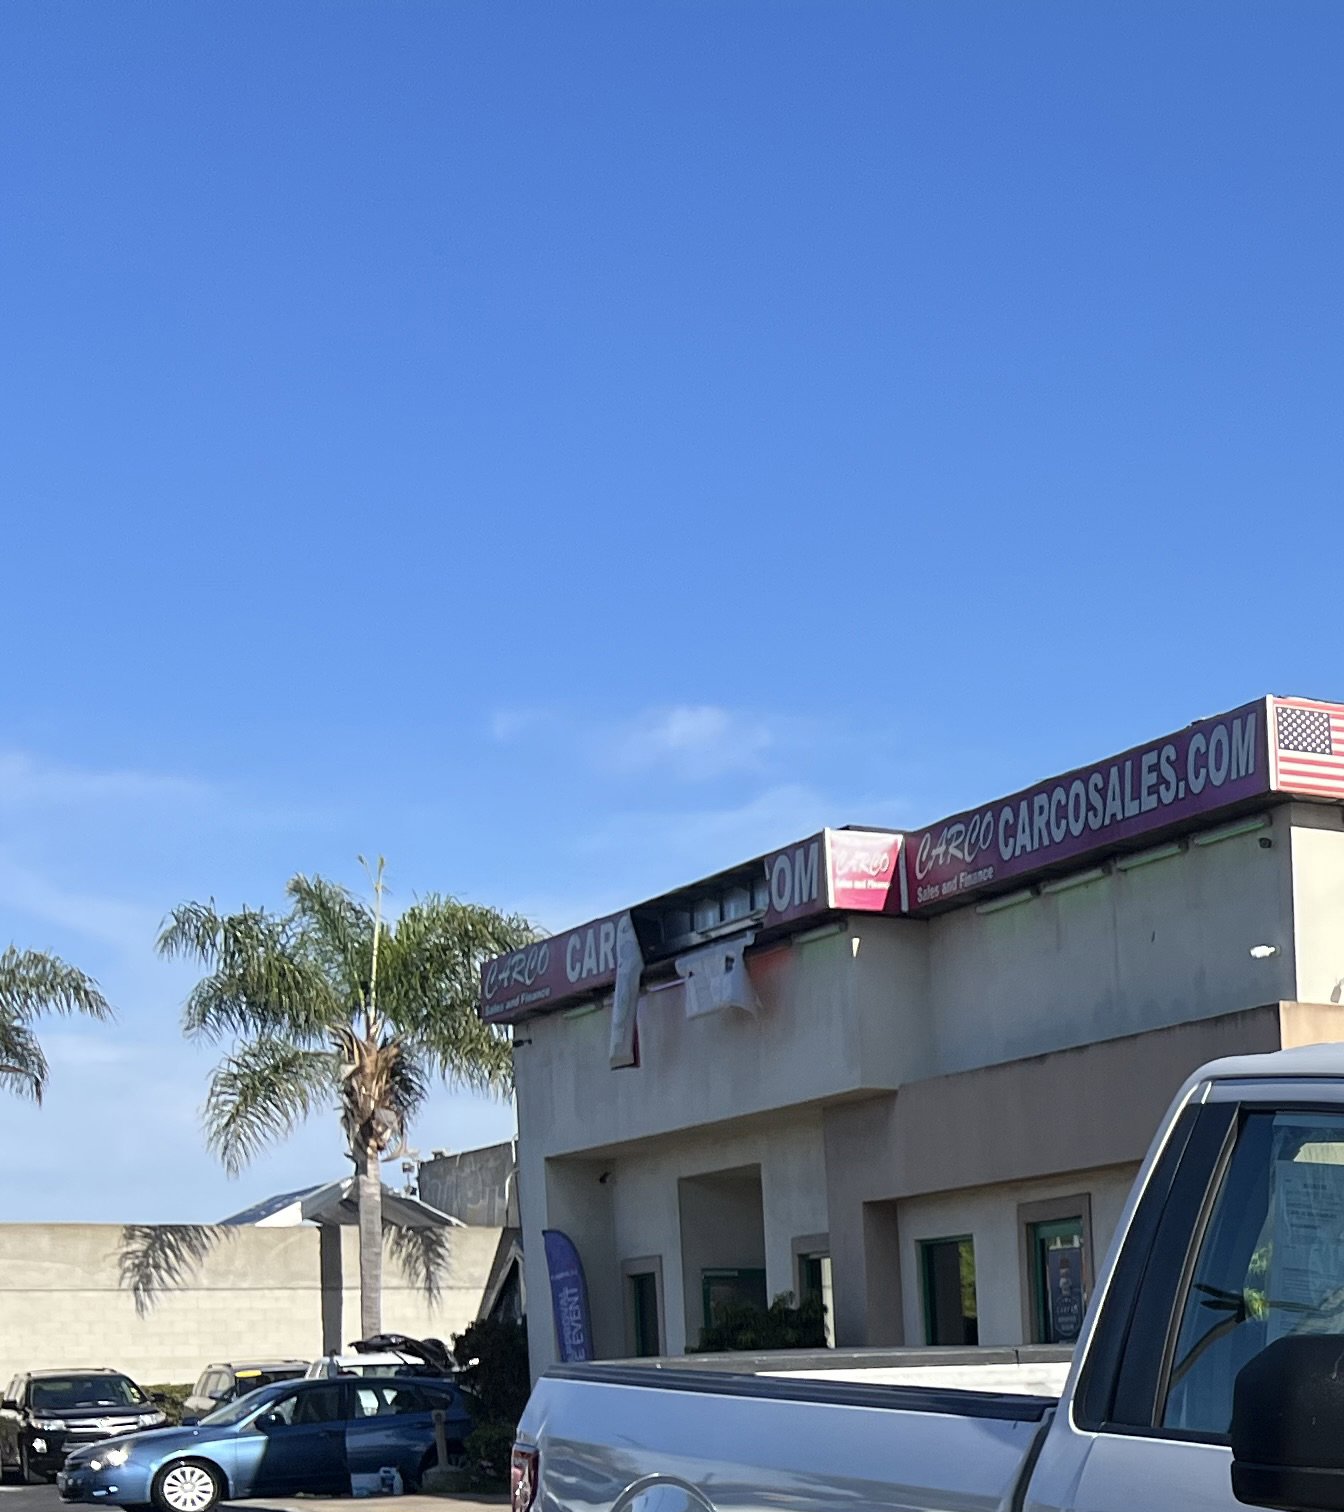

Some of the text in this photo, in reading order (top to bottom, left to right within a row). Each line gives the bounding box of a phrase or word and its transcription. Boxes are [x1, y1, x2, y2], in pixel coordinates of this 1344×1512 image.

[915, 810, 994, 880] CARCO
[999, 713, 1257, 862] CARCOSALES.COM
[917, 866, 994, 903] Sales and Finance
[485, 943, 550, 1000] CARCO
